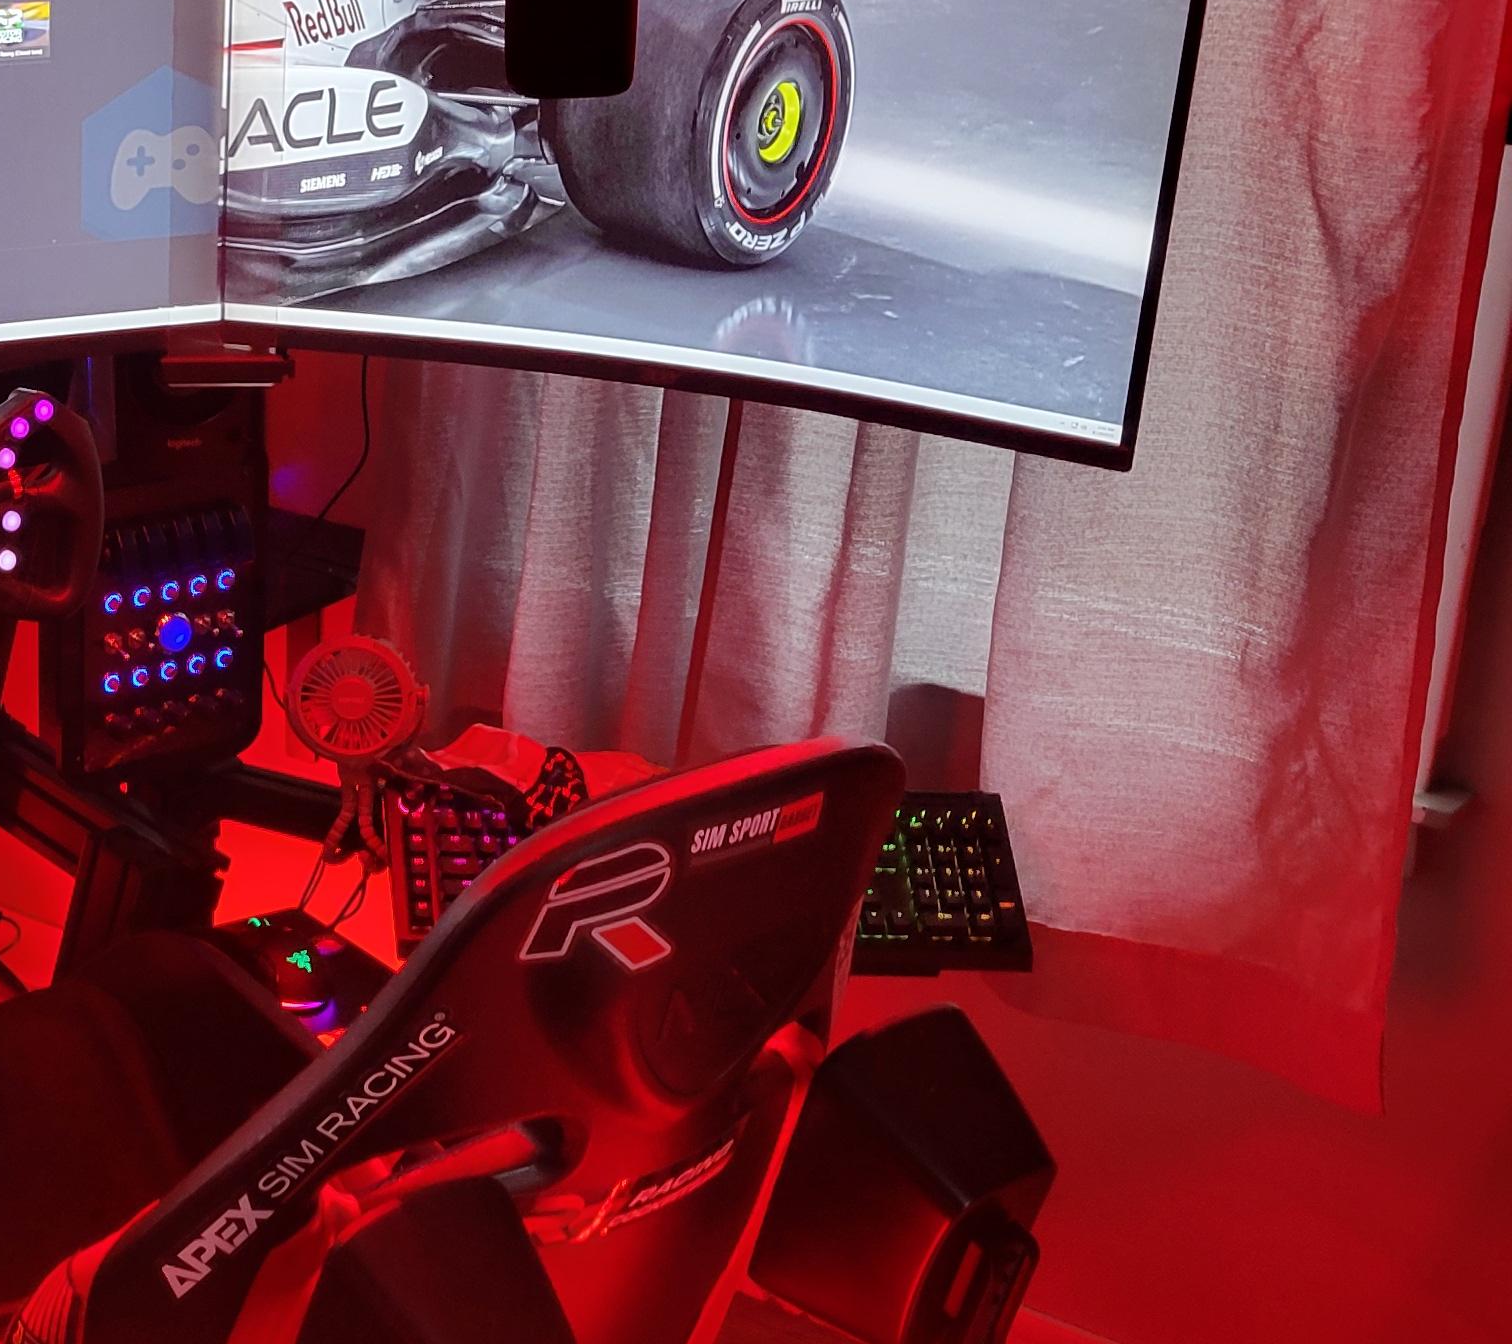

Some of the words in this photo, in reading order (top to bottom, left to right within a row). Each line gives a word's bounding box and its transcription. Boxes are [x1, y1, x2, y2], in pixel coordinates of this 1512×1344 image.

[299, 173, 346, 194] SIEMENS
[728, 220, 788, 252] ZERO
[790, 209, 807, 241] P
[690, 823, 728, 854] SIM
[728, 807, 781, 845] SPORT
[161, 1192, 275, 1299] APEX
[258, 1138, 324, 1199] SIM
[316, 1022, 456, 1142] RACING
